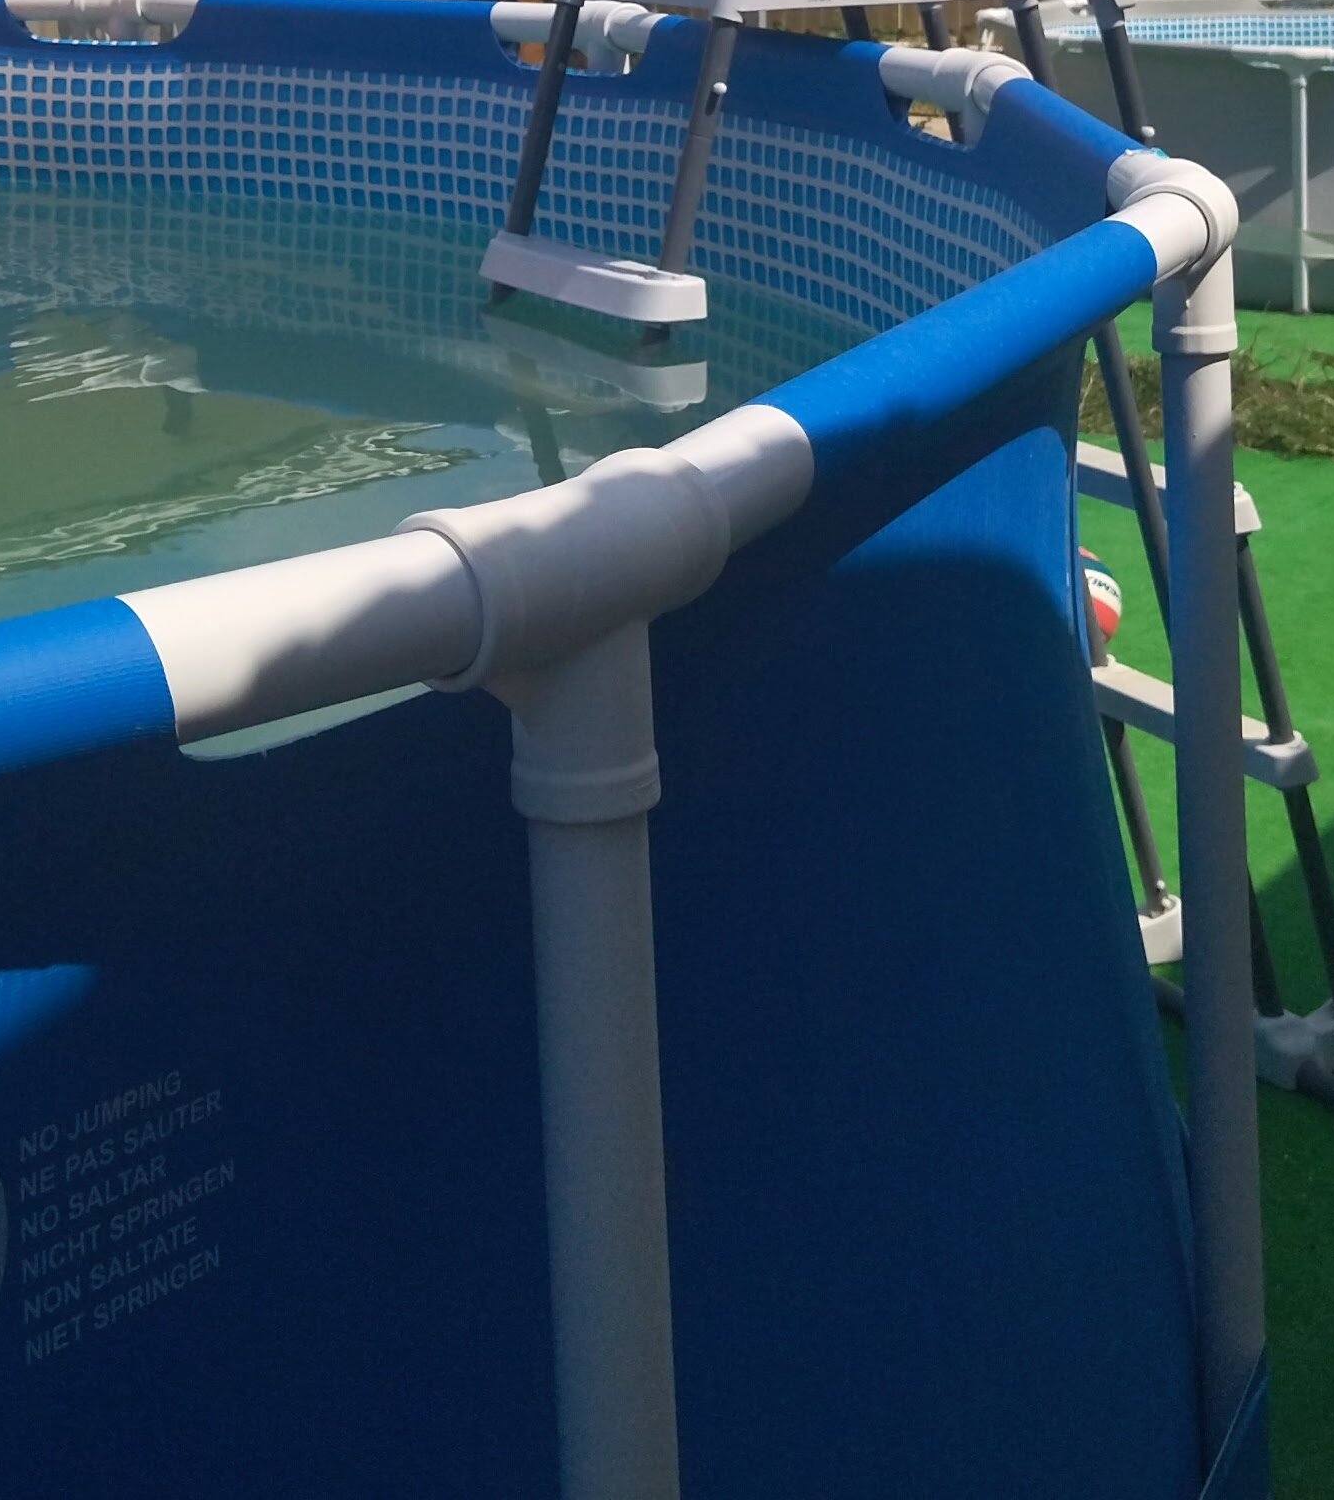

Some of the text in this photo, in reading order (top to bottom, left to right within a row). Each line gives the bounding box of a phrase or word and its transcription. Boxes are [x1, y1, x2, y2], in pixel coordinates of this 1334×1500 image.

[19, 1069, 182, 1162] NO JUMPING
[19, 1088, 223, 1202] NE PAS SAUTER
[20, 1153, 167, 1242] NO SALTAR
[21, 1157, 236, 1285] NICHT SPRINGEN
[23, 1215, 198, 1325] NON SALTATE
[25, 1243, 221, 1366] NIET SPRINGEN
